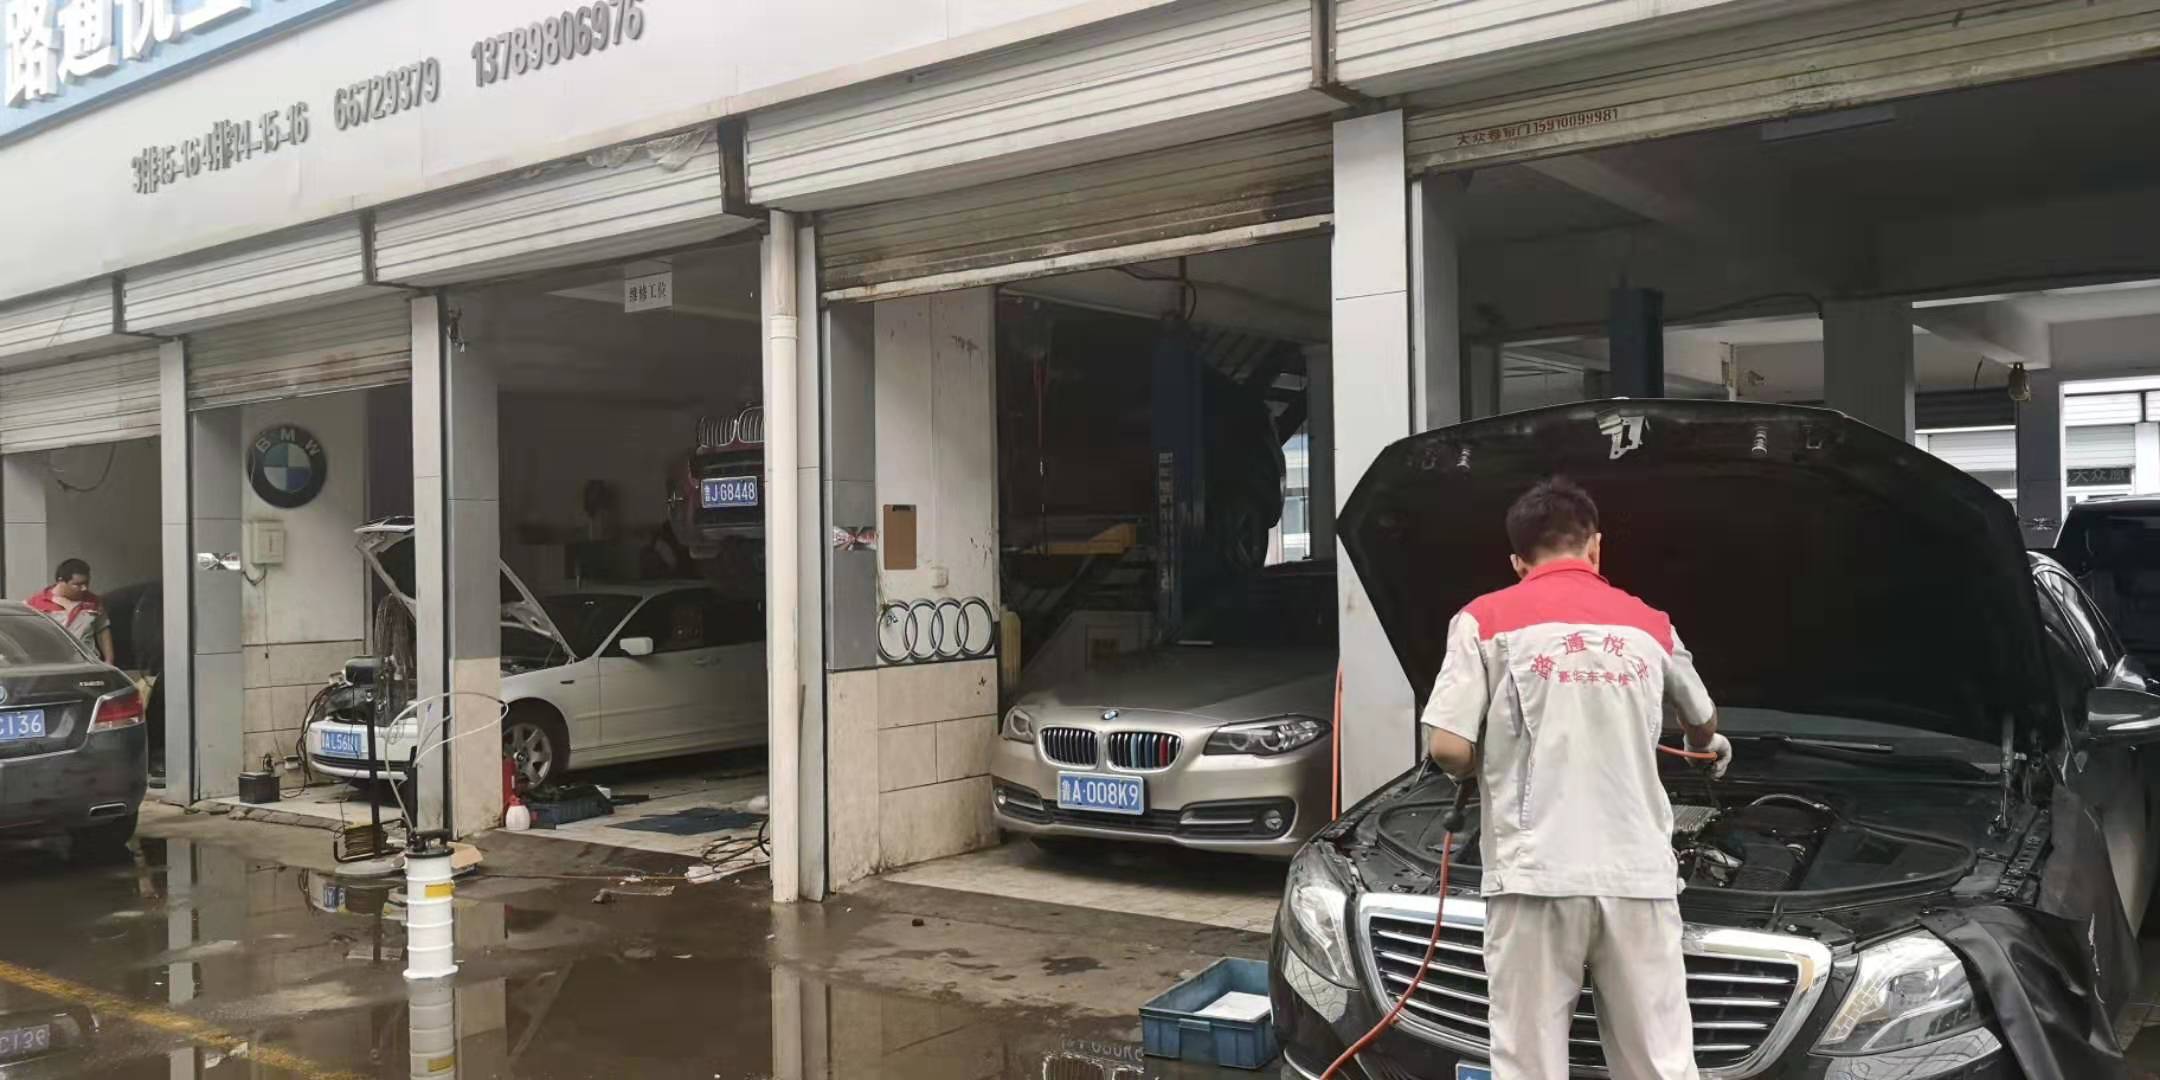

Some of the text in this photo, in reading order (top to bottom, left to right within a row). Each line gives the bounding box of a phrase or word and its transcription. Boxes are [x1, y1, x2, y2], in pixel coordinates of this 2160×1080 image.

[334, 58, 440, 131] 66729379
[471, 0, 645, 88] 13789806976
[255, 428, 321, 457] BMW
